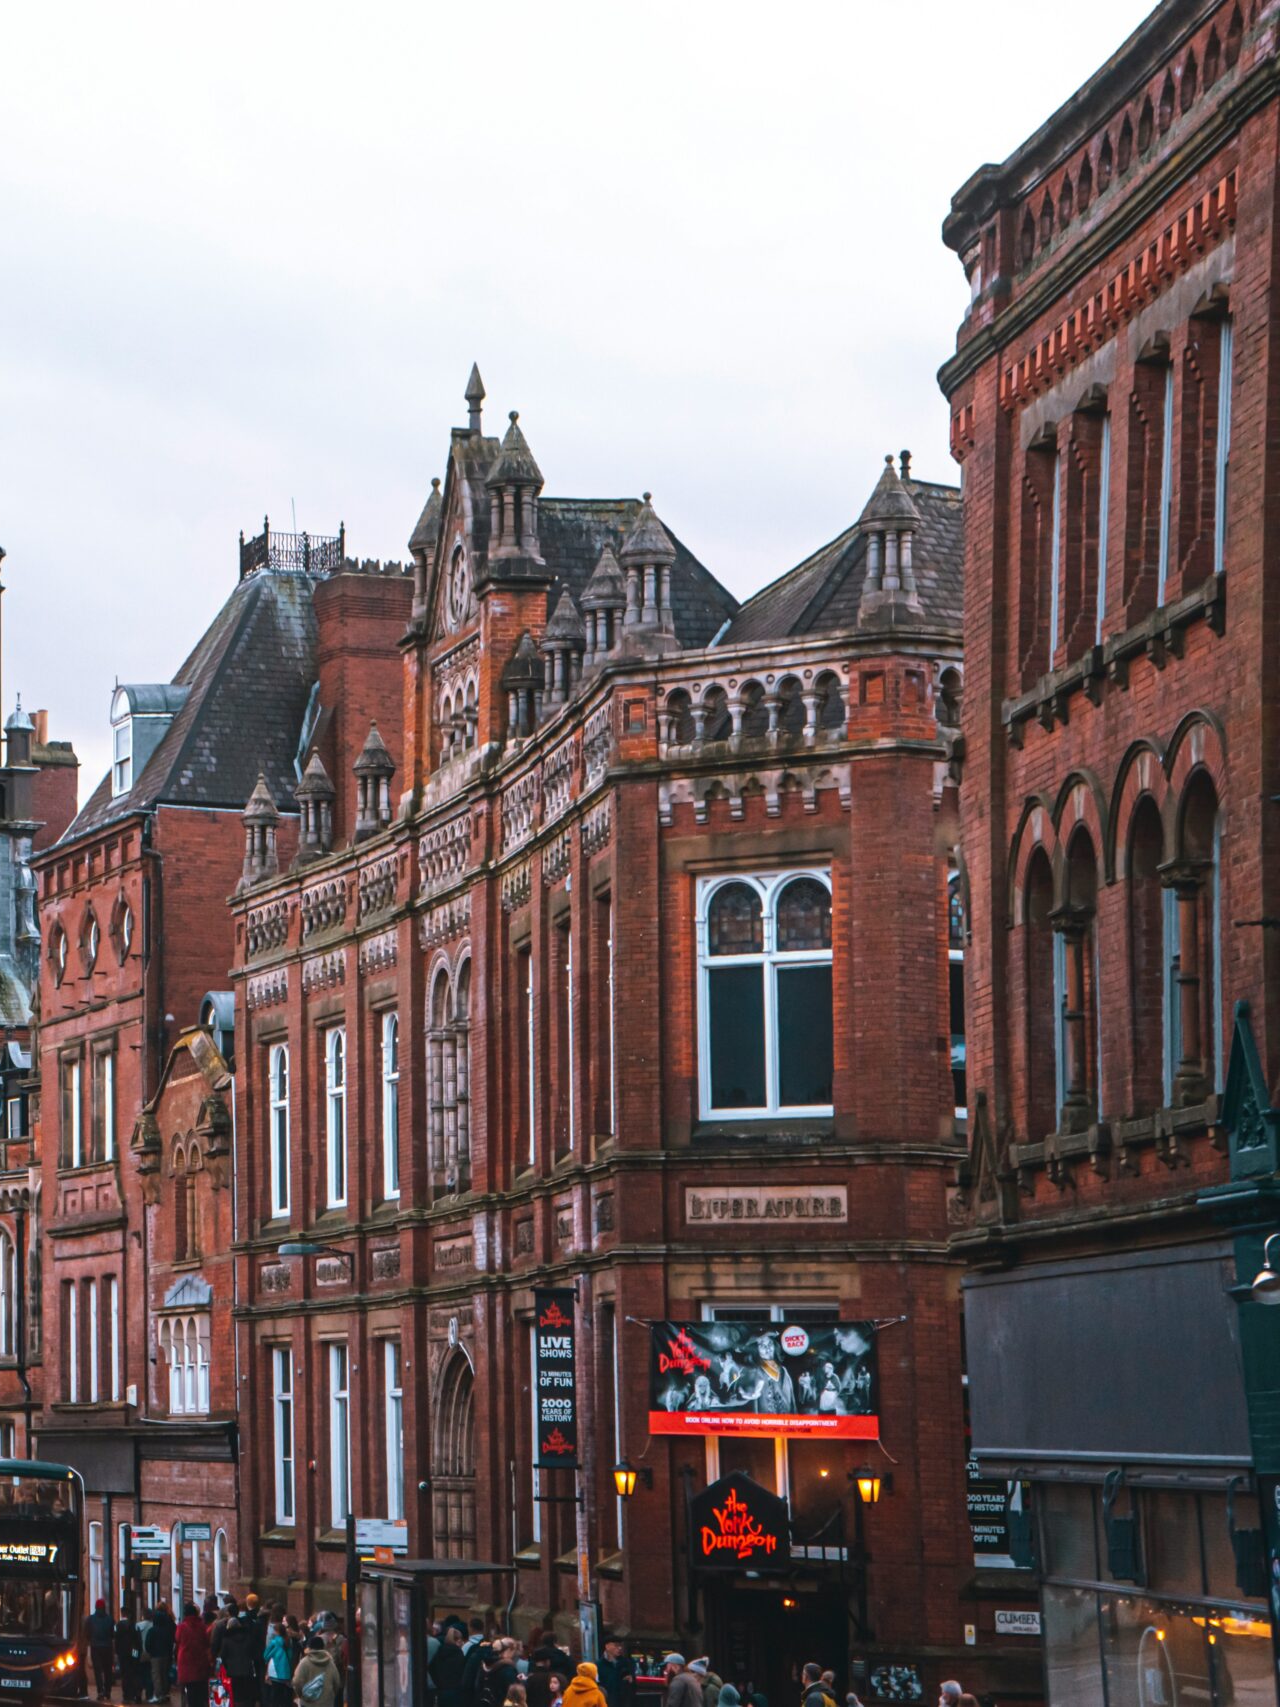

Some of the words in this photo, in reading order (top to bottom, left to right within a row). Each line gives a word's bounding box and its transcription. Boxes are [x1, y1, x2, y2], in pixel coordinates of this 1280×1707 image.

[540, 1336, 572, 1349] LIVE
[540, 1349, 572, 1359] SHOWS
[540, 1377, 552, 1387] OF
[554, 1377, 573, 1387] FUN
[542, 1399, 572, 1408] 2000
[542, 1414, 573, 1422] HISTORY
[725, 1488, 748, 1512] the
[982, 1495, 1005, 1503] YEARS
[974, 1504, 1004, 1512] HISTORY
[712, 1507, 762, 1535] York
[975, 1526, 1005, 1534] MINUTES
[700, 1526, 776, 1559] Dungeon
[974, 1535, 983, 1543] OF
[9, 1544, 29, 1554] Outlet
[48, 1546, 58, 1563] 7
